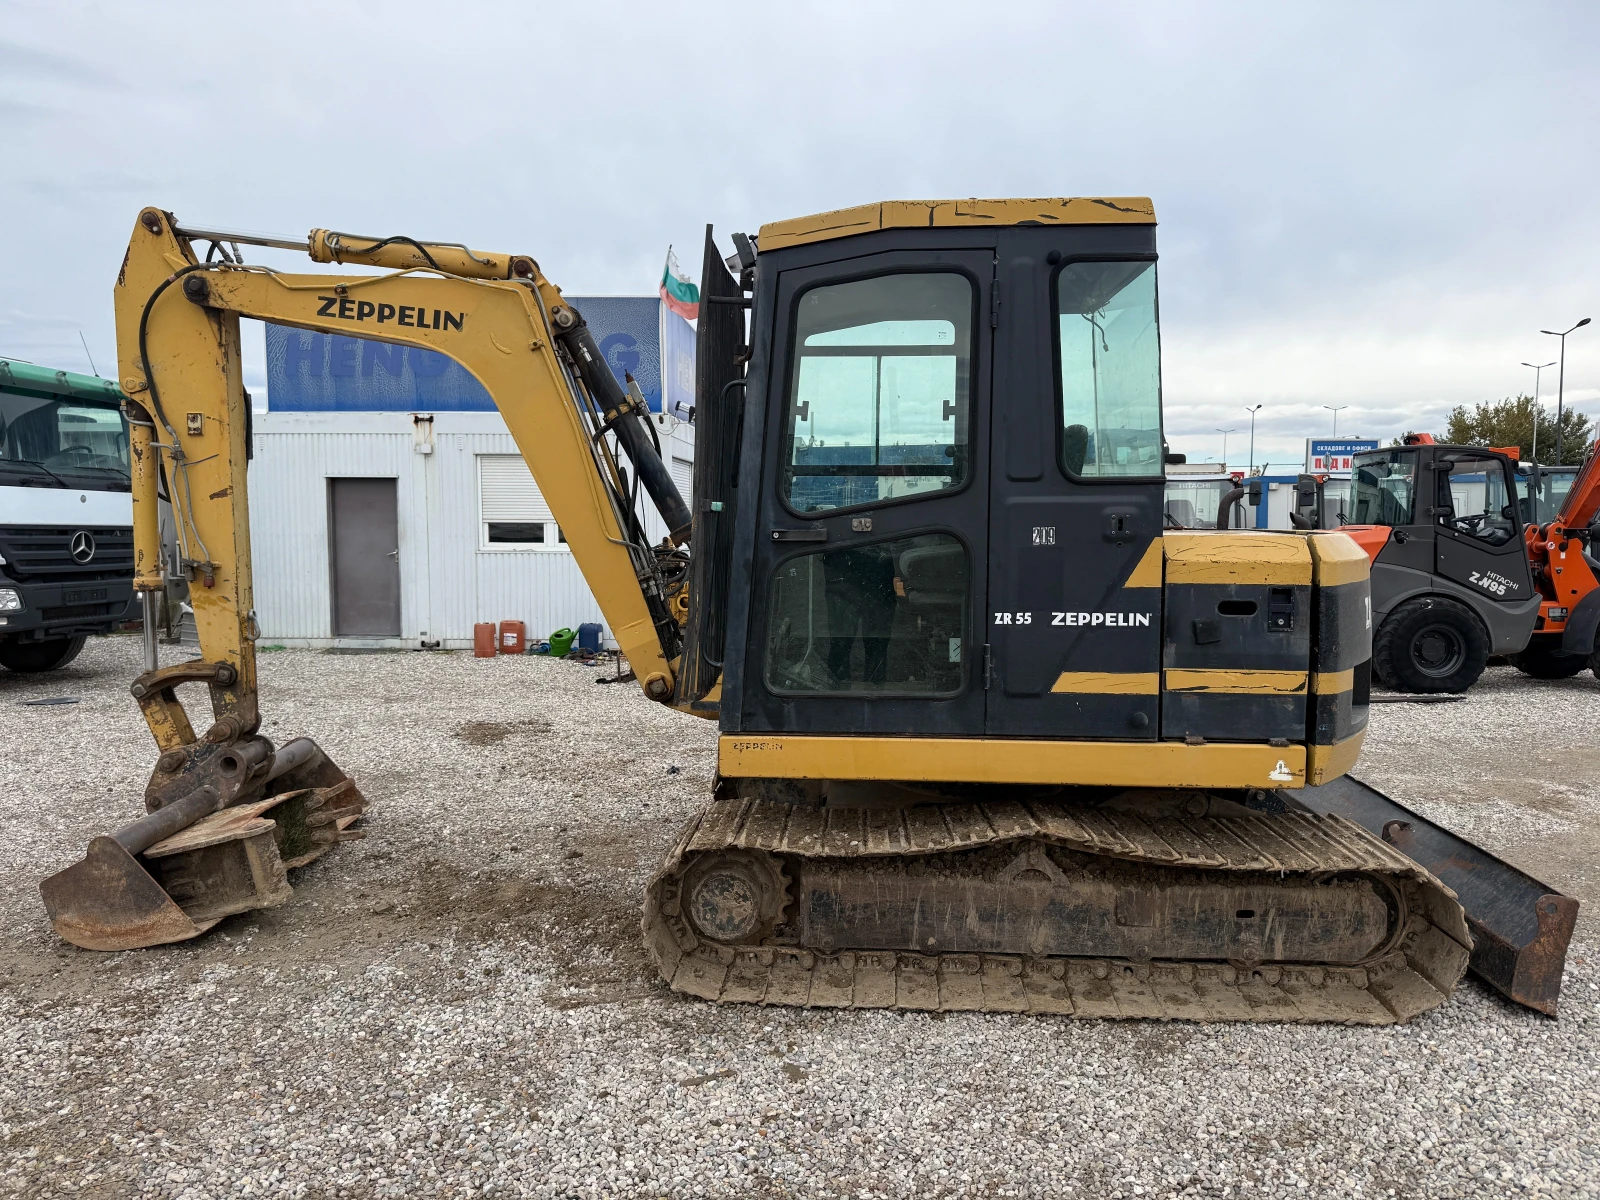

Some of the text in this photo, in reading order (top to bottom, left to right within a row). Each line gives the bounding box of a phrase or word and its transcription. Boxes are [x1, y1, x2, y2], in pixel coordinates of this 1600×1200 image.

[317, 296, 465, 332] ZEPPELIN
[1486, 570, 1519, 590] HITACHI
[994, 612, 1032, 625] ZR 55
[1051, 612, 1150, 626] ZEPPELIN
